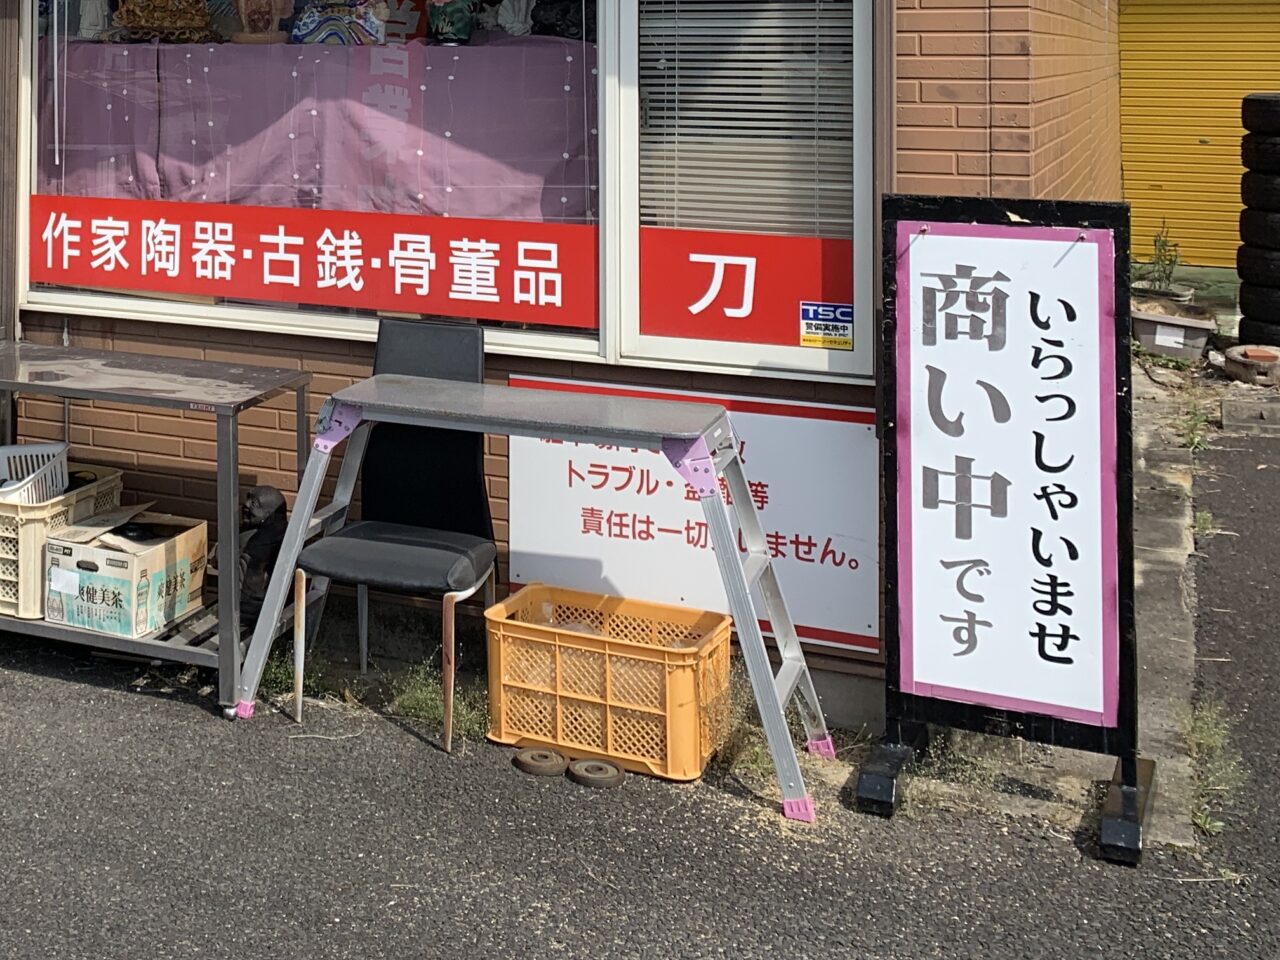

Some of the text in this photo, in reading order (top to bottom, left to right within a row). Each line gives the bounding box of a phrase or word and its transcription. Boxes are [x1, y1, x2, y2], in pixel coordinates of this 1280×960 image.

[41, 210, 563, 308] 作家陶器・古銭・骨董品
[687, 252, 758, 320] 刀
[802, 305, 852, 320] TSC
[920, 263, 1013, 657] 商い中です
[1027, 290, 1081, 666] いらっしゃいませ
[580, 506, 860, 571] 責任は一切ません。
